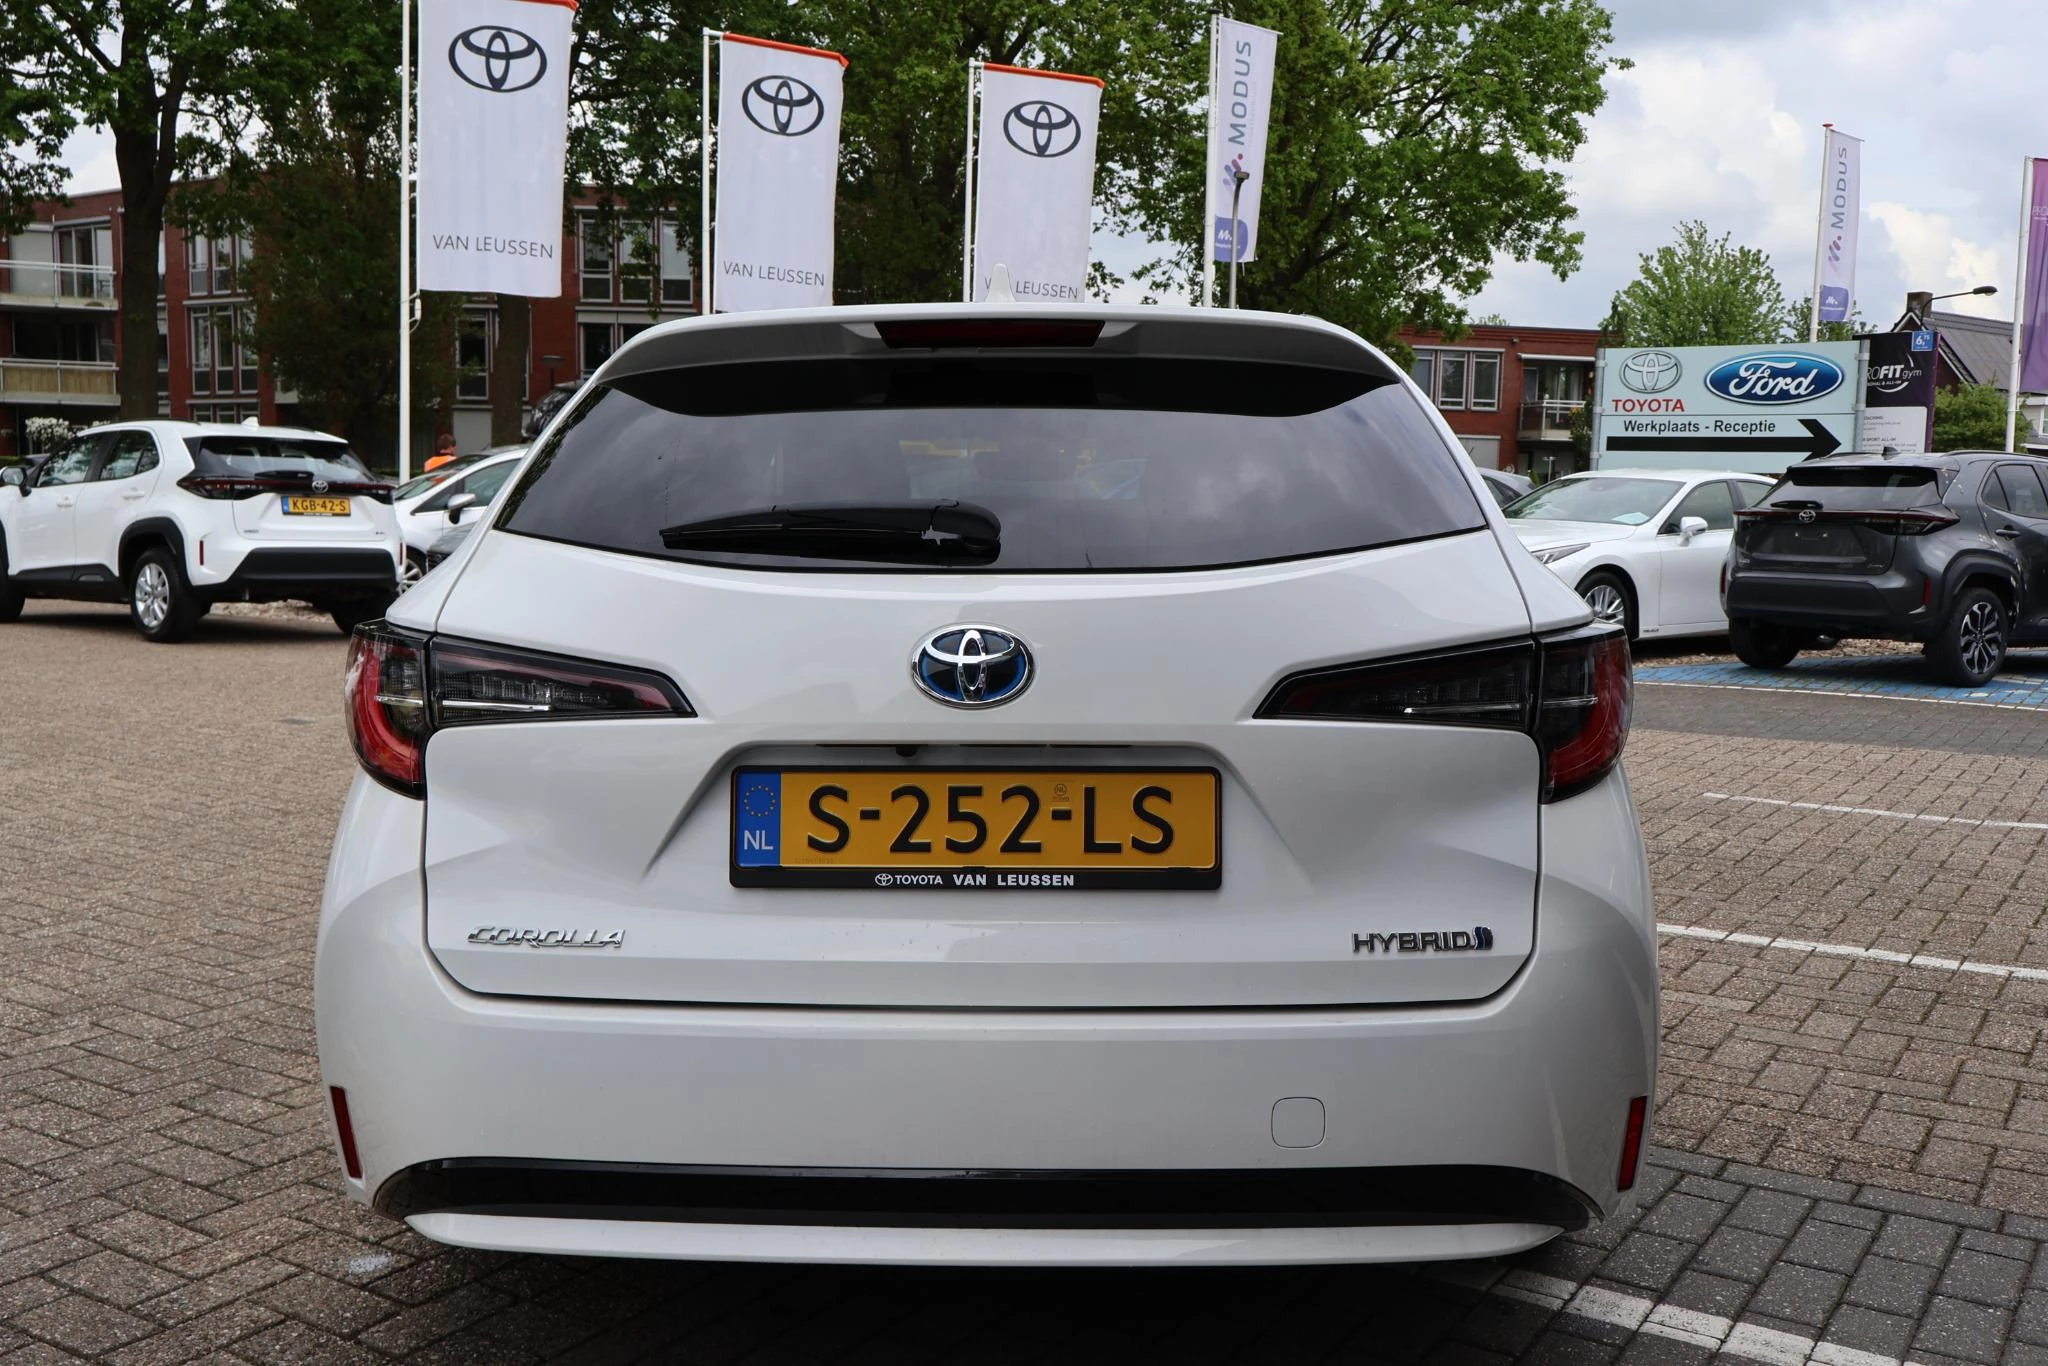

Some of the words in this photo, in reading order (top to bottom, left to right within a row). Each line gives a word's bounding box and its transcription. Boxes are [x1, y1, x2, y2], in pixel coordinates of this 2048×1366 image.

[1227, 40, 1251, 146] MODUS
[1831, 146, 1848, 230] MODUS
[432, 234, 469, 251] VAN
[475, 236, 553, 259] LEUSSEN
[723, 261, 753, 278] VAN
[758, 265, 825, 287] LEUSSEN
[1015, 280, 1078, 299] LEUSSEN
[1727, 360, 1819, 396] Ford
[1866, 364, 1905, 380] ROFIT
[1902, 369, 1922, 379] gym
[1611, 398, 1685, 413] TOYOTA
[1623, 419, 1700, 435] Werkplaats
[1713, 419, 1776, 435] Receptie
[292, 498, 346, 512] KGB-42-S
[743, 829, 774, 851] NL
[807, 784, 1175, 855] S-252-LS
[895, 875, 943, 885] TOYOTA
[953, 874, 987, 886] VAN
[997, 874, 1074, 886] LEUSSEN
[467, 925, 626, 949] COROLLA
[1352, 931, 1472, 952] HYBRID
